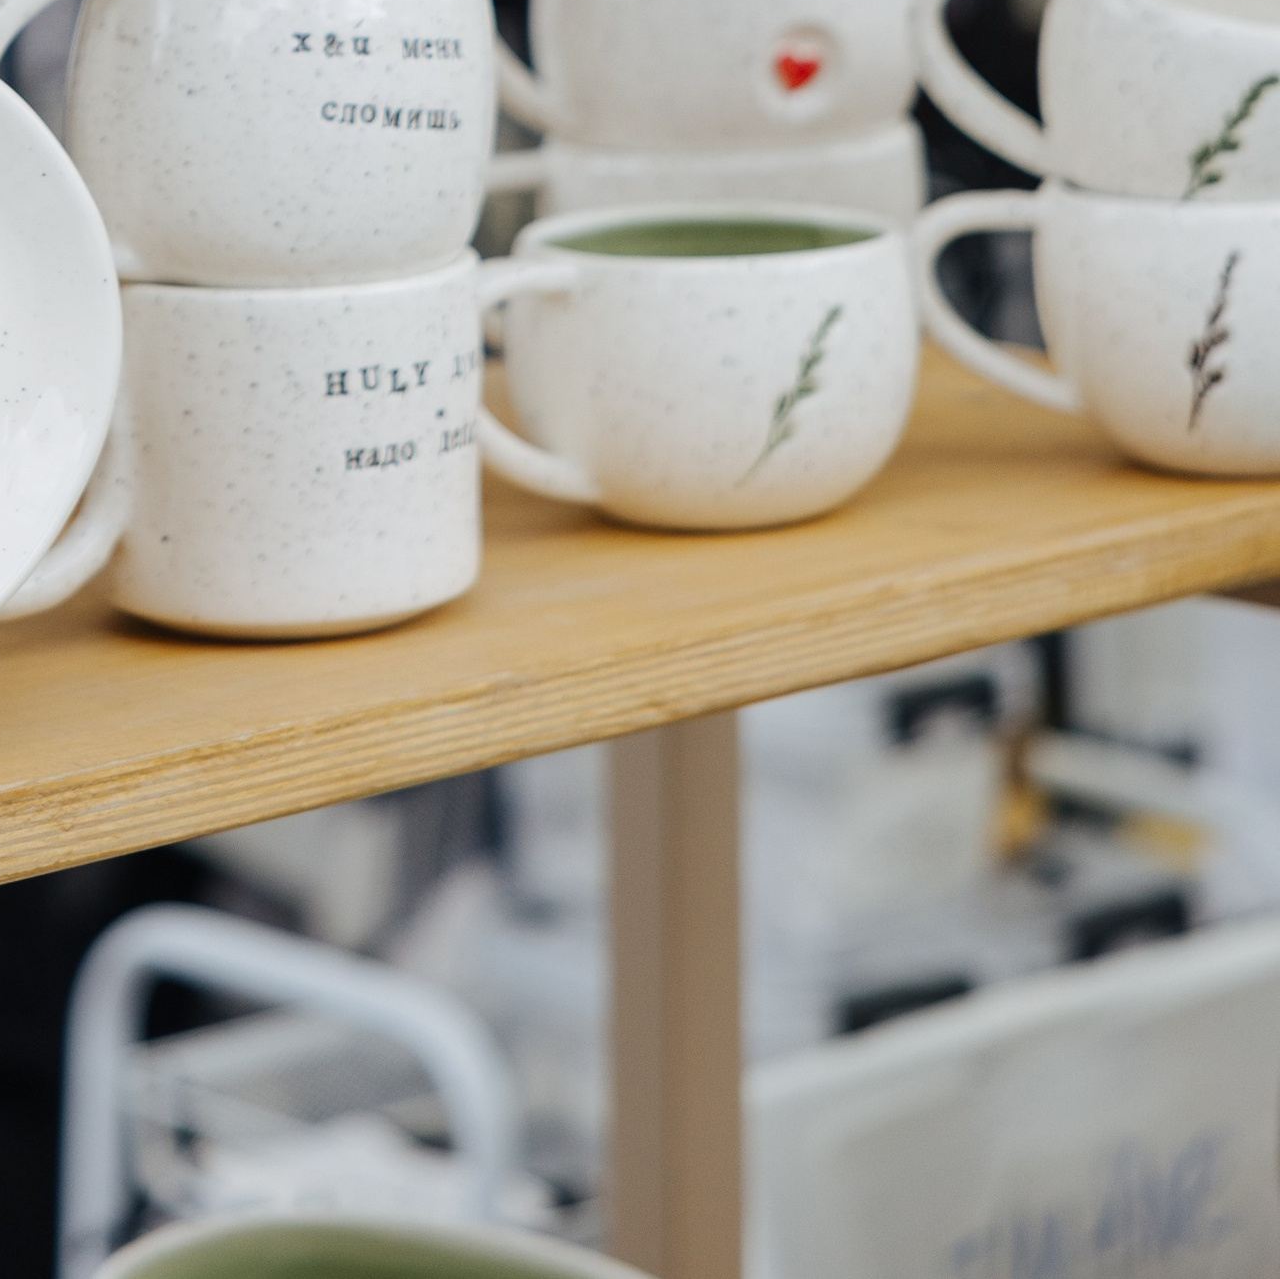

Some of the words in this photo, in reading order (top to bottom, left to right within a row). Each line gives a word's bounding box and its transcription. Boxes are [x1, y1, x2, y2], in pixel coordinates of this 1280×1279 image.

[320, 100, 461, 130] сломишь
[324, 360, 430, 396] HULY
[344, 439, 416, 471] надо
